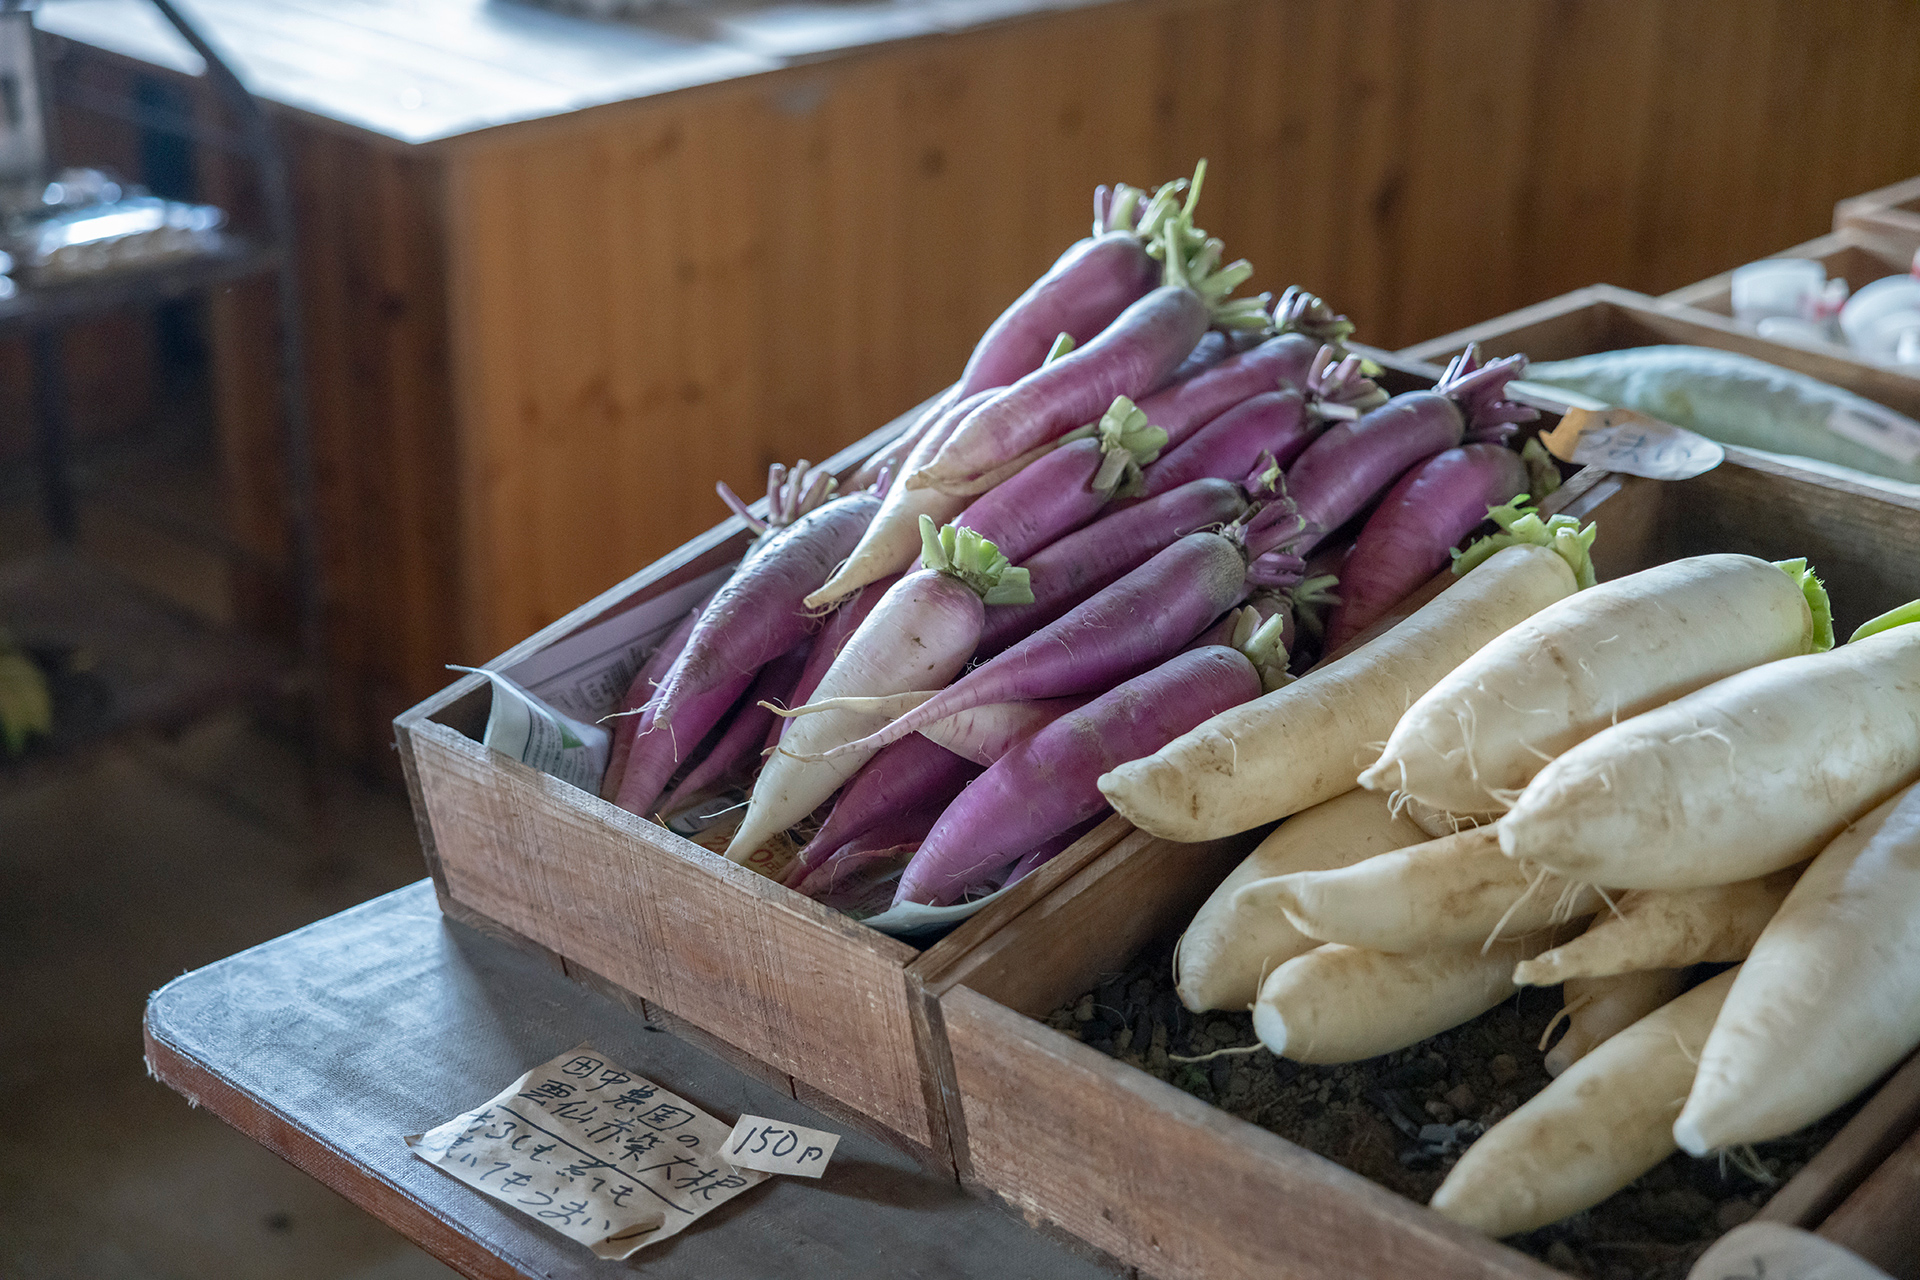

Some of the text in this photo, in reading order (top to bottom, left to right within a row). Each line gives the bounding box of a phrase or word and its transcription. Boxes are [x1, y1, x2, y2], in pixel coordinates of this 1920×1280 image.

[562, 1056, 700, 1148] 田中農園の
[733, 1126, 824, 1164] 150円
